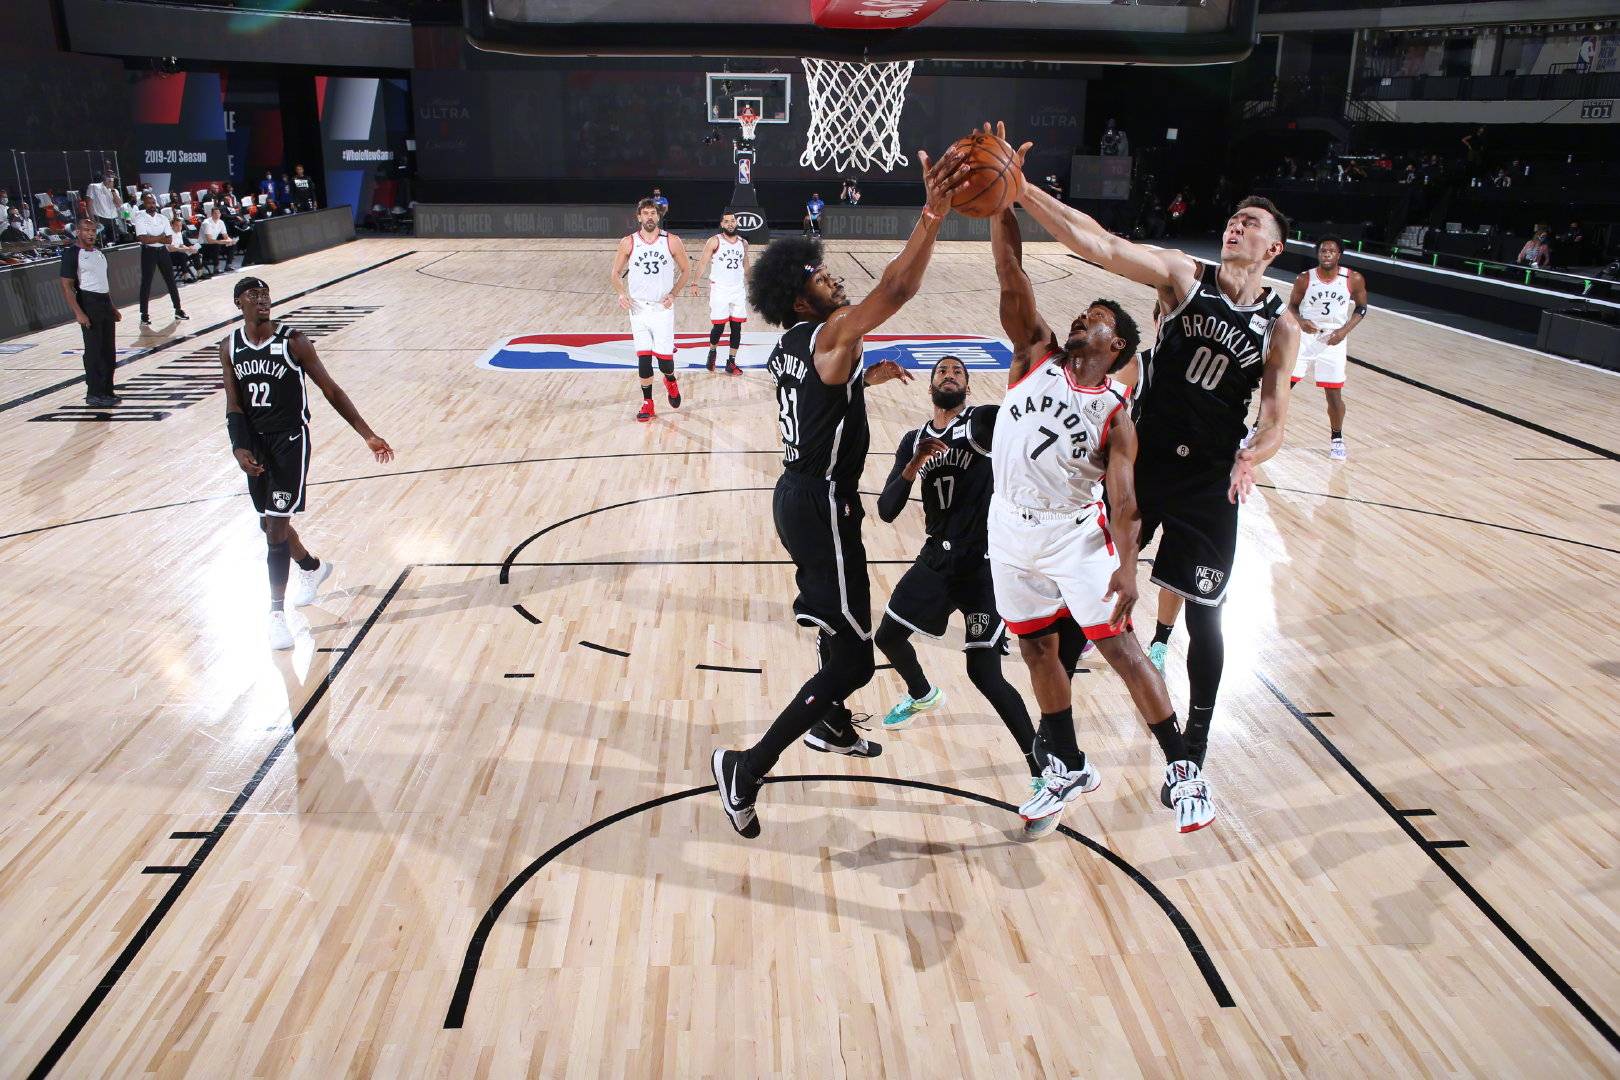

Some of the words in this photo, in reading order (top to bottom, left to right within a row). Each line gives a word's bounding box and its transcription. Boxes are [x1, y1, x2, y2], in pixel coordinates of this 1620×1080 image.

[419, 106, 471, 120] ULTRA
[1030, 114, 1077, 127] ULTRA
[1582, 107, 1610, 118] 101
[144, 149, 177, 164] 2019-20
[178, 149, 207, 164] Season
[418, 213, 440, 234] TAP
[441, 213, 456, 234] TO
[458, 213, 493, 234] CHEER
[826, 215, 847, 235] TAP
[848, 215, 863, 235] TO
[864, 215, 898, 235] CHEER
[634, 250, 668, 267] RAPTORS
[726, 258, 739, 270] 23
[643, 261, 660, 275] 33
[1321, 301, 1331, 316] 3
[1181, 314, 1261, 369] BROOKLYN
[1185, 346, 1230, 391] 00
[248, 381, 272, 407] 22
[1009, 395, 1088, 459] RAPTORS
[1030, 425, 1059, 461] 7
[933, 475, 955, 510] 17
[1196, 567, 1222, 583] NETS
